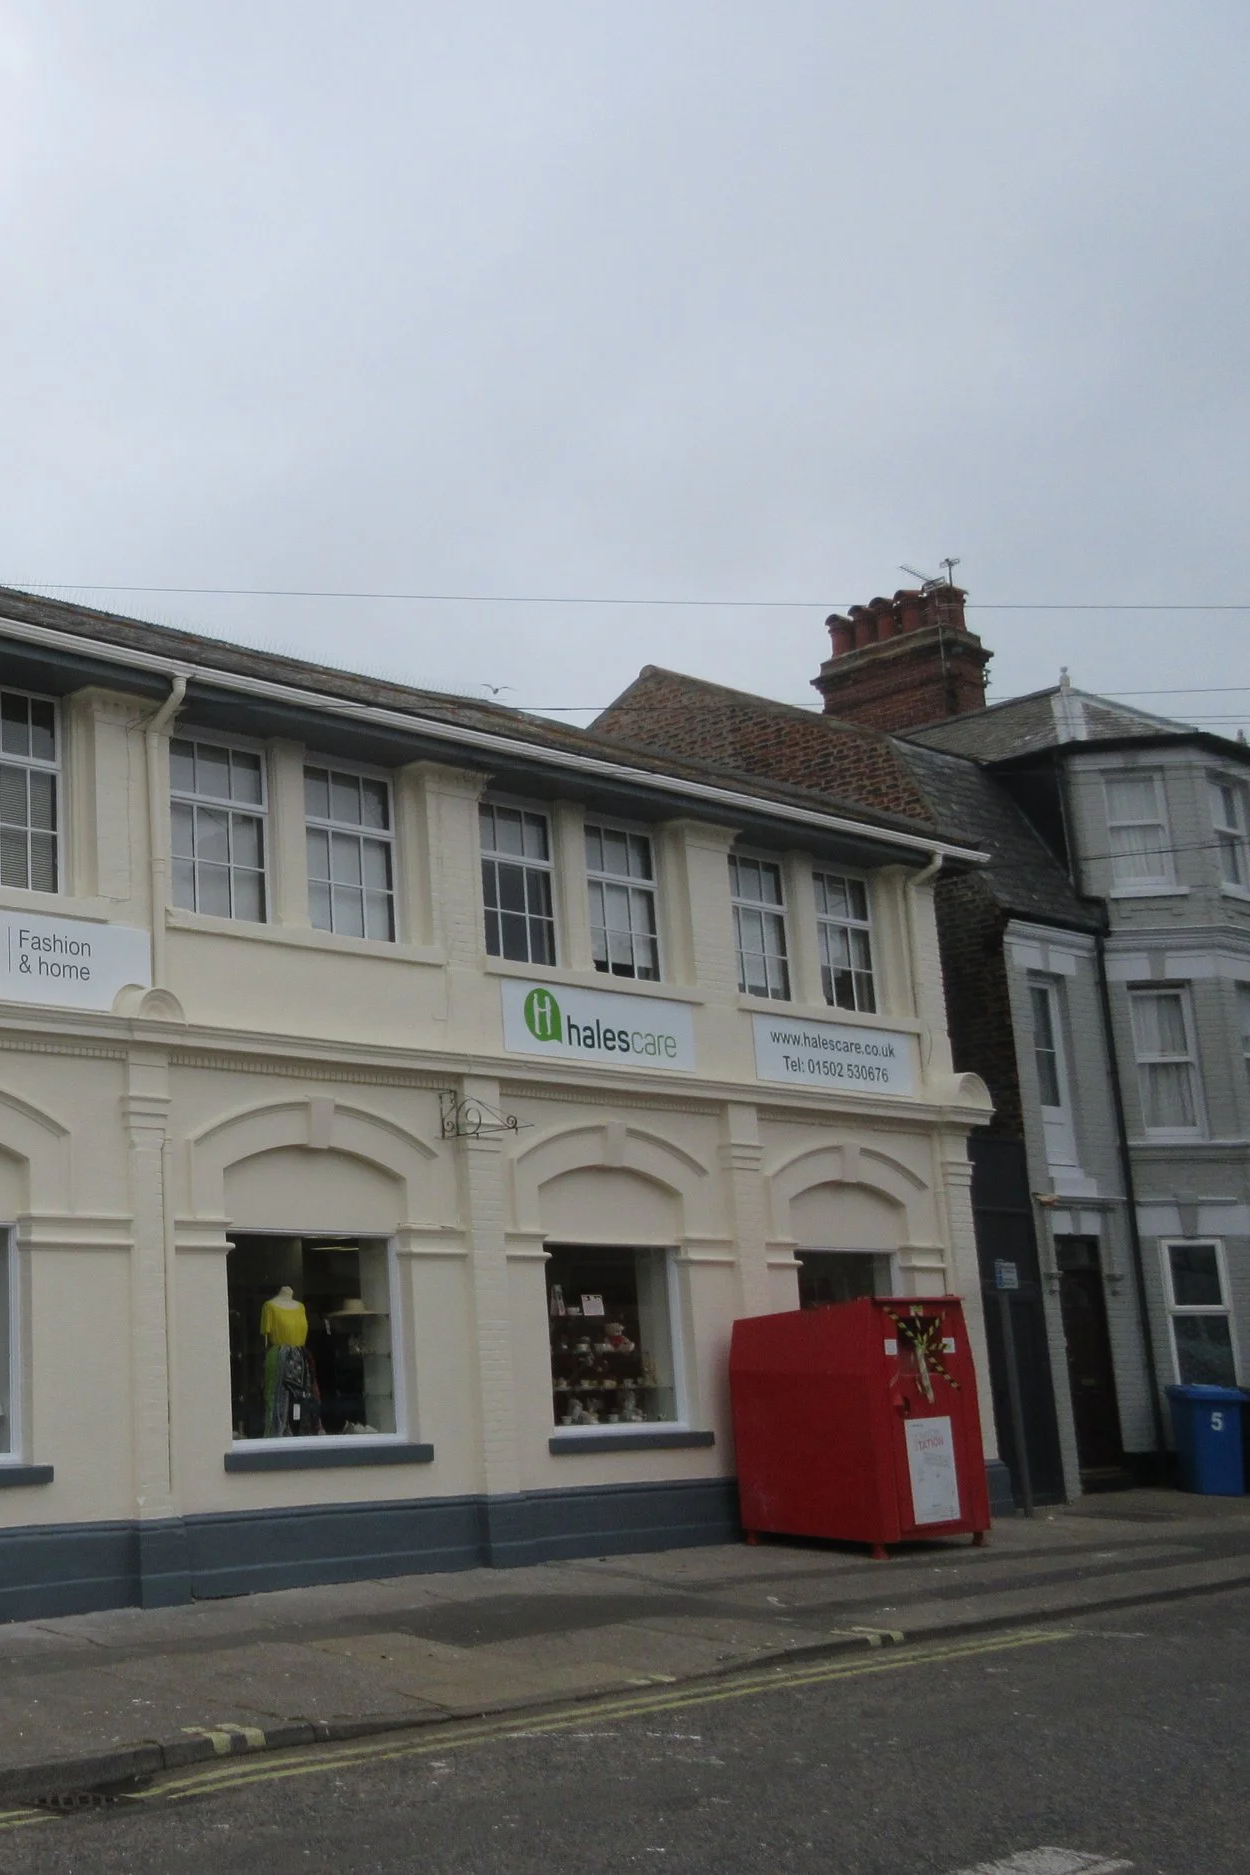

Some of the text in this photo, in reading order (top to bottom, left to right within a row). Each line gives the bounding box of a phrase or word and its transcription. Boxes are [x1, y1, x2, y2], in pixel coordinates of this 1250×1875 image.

[18, 929, 92, 957] Fashion
[18, 956, 91, 981] & home
[770, 1030, 896, 1058] www.halescare.co.uk
[783, 1055, 889, 1083] Tel: 01502 530676
[1210, 1412, 1223, 1431] 5
